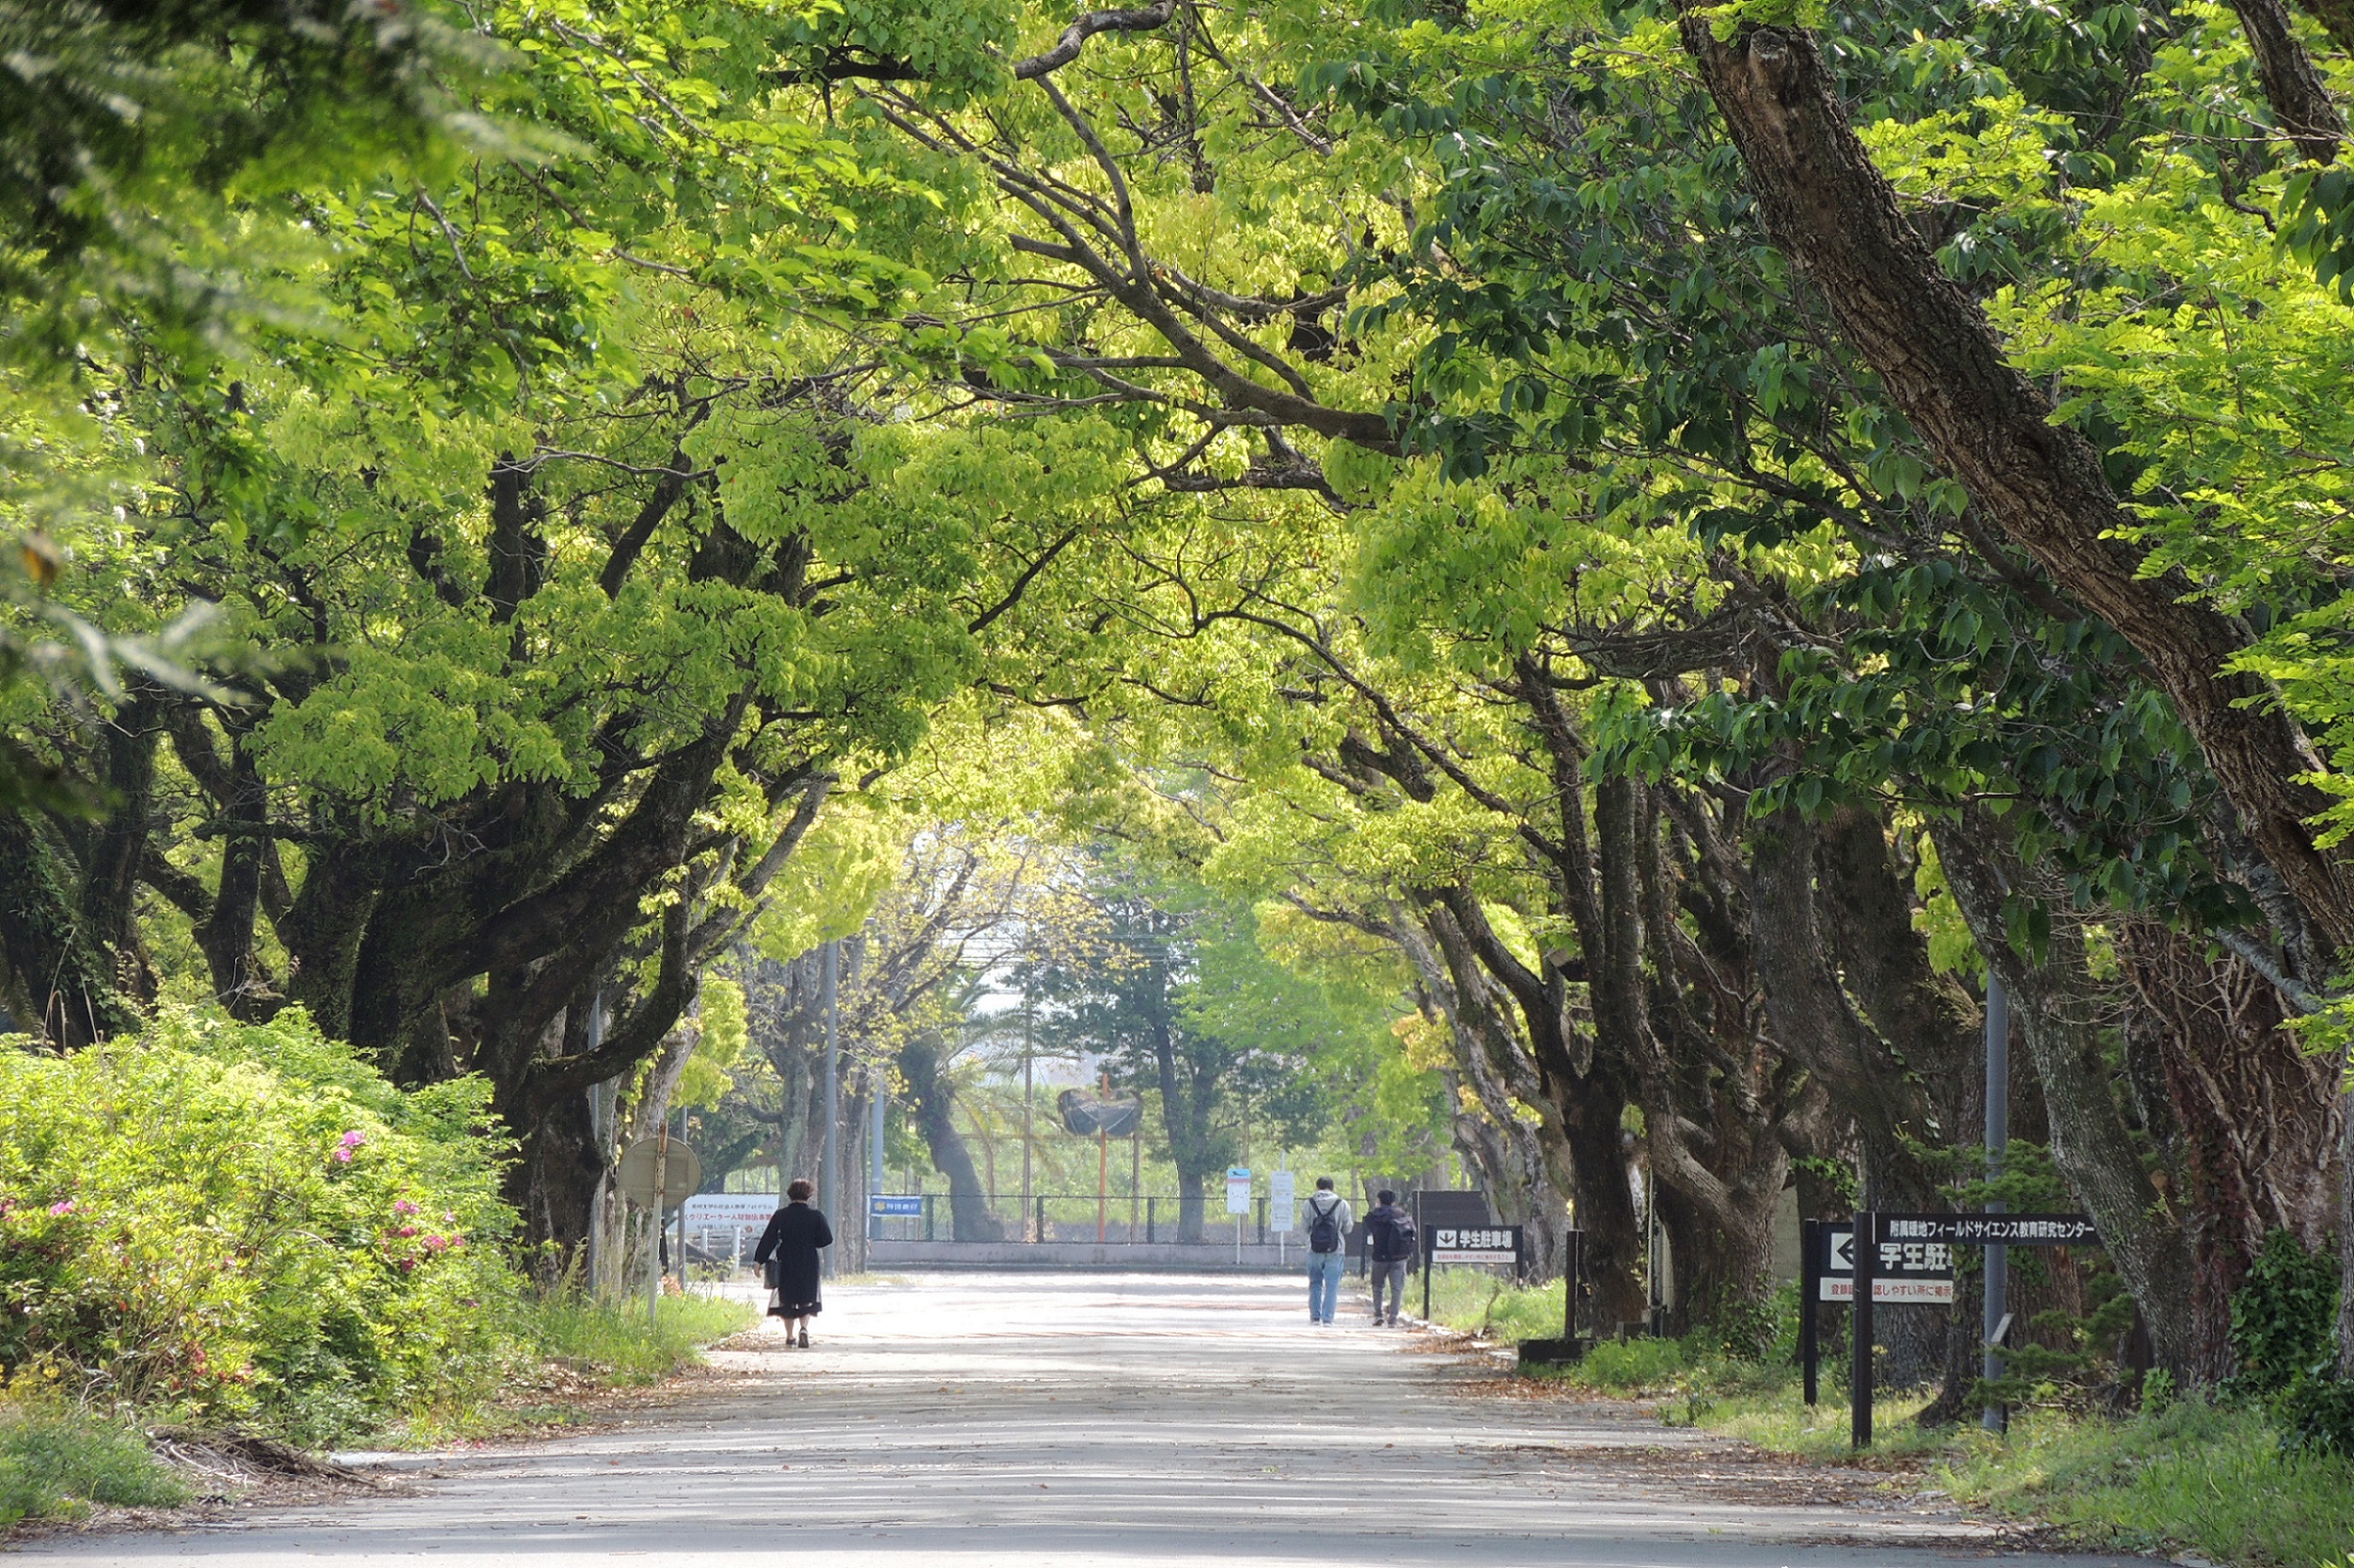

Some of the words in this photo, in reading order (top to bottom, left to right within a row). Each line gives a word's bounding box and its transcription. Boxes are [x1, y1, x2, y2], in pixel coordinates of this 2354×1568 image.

[1890, 1220, 2095, 1238] 附属暖地フィールドサイエンス教育研究センター
[1459, 1230, 1513, 1249] 学生駐車場
[1879, 1243, 1954, 1271] 学生駐
